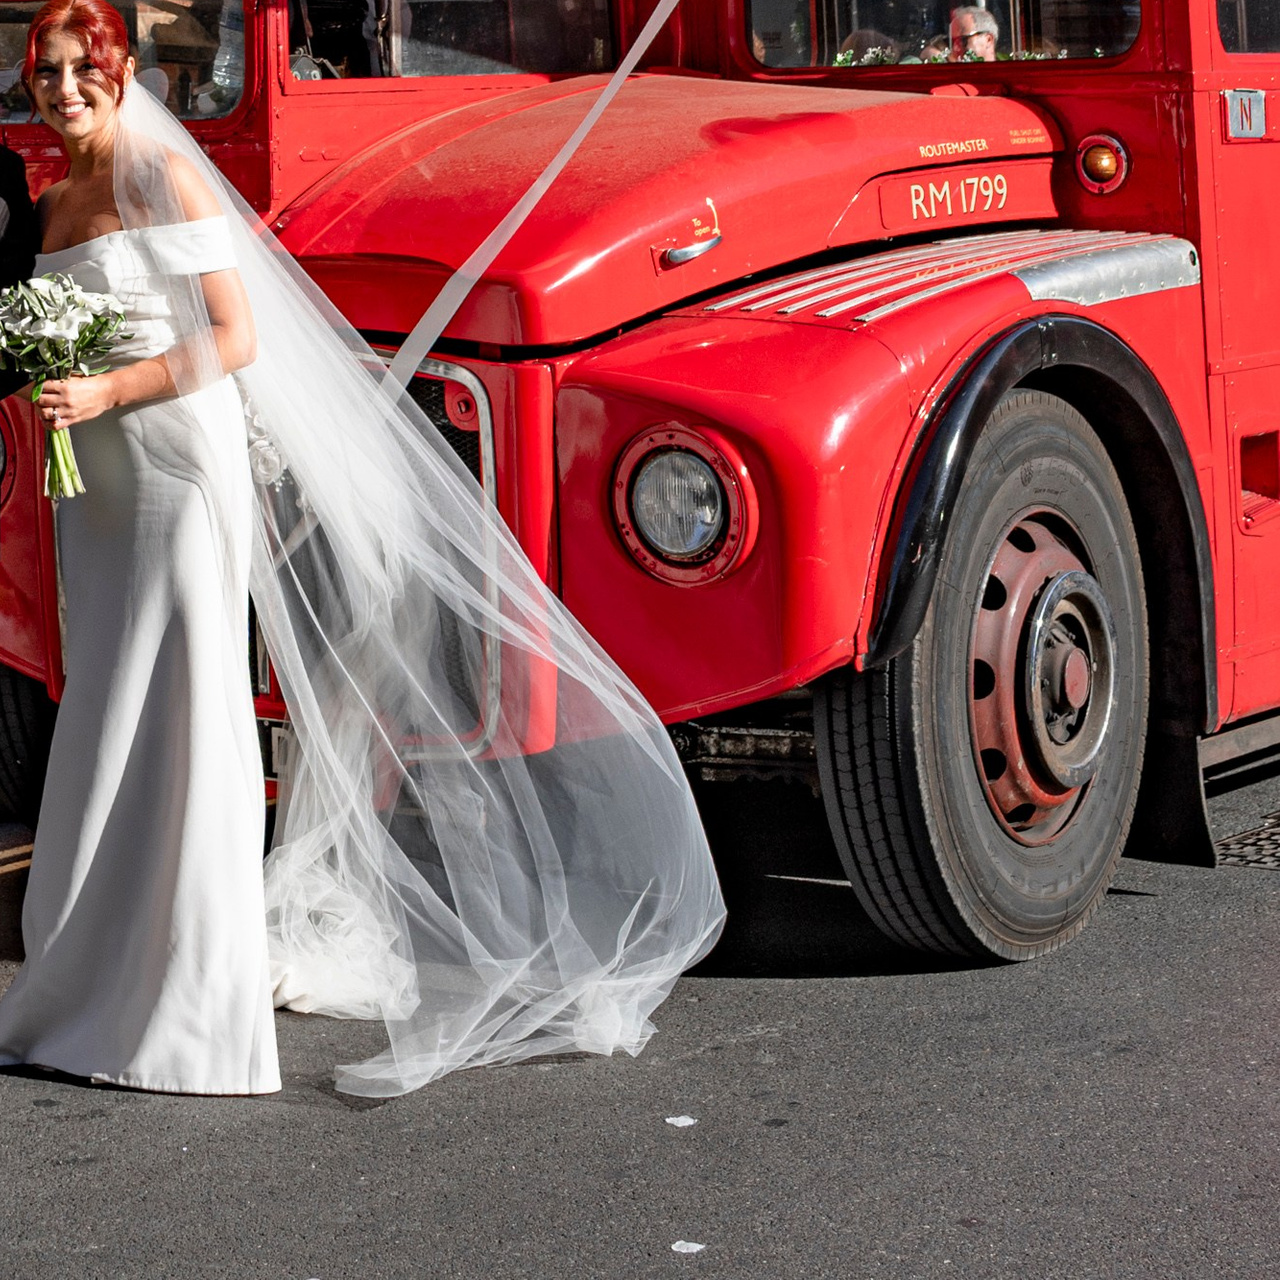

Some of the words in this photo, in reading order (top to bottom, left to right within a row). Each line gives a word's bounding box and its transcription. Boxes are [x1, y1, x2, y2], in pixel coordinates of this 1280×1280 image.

[919, 138, 989, 158] ROUTEMASTER
[910, 180, 953, 220] RM
[960, 174, 1008, 214] 1799
